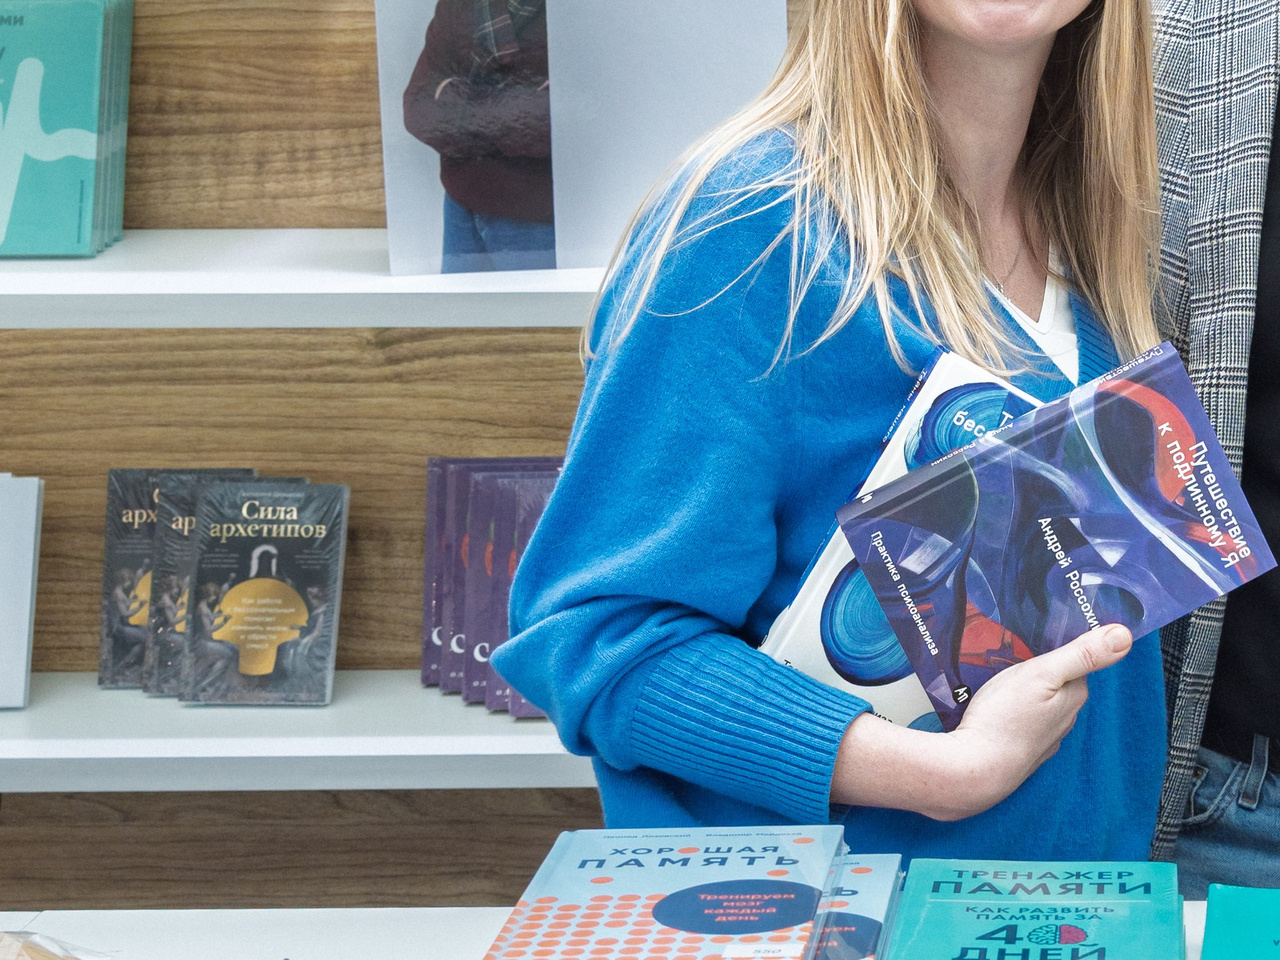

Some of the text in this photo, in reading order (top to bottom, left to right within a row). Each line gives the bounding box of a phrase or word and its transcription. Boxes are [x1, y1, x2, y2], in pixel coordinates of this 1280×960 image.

[1166, 440, 1227, 548] подлинному
[1220, 551, 1240, 569] Я
[1188, 441, 1251, 559] Путешествие
[241, 500, 298, 520] Сила
[209, 522, 327, 544] архетипов
[1038, 517, 1073, 569] Андрей
[870, 530, 939, 656] Практика психоанализа
[577, 855, 800, 869] ПАМЯТЬ
[952, 869, 1135, 881] ТРЕНАЖЕР
[931, 880, 1152, 896] ПАМЯТИ
[698, 893, 796, 901] Тренируем
[704, 906, 777, 915] каждый
[965, 906, 1116, 914] КАК РАЗВИТЬ
[975, 913, 1103, 921] ПАМЯТЬ ЗА
[950, 944, 1107, 960] ДНЕЙ
